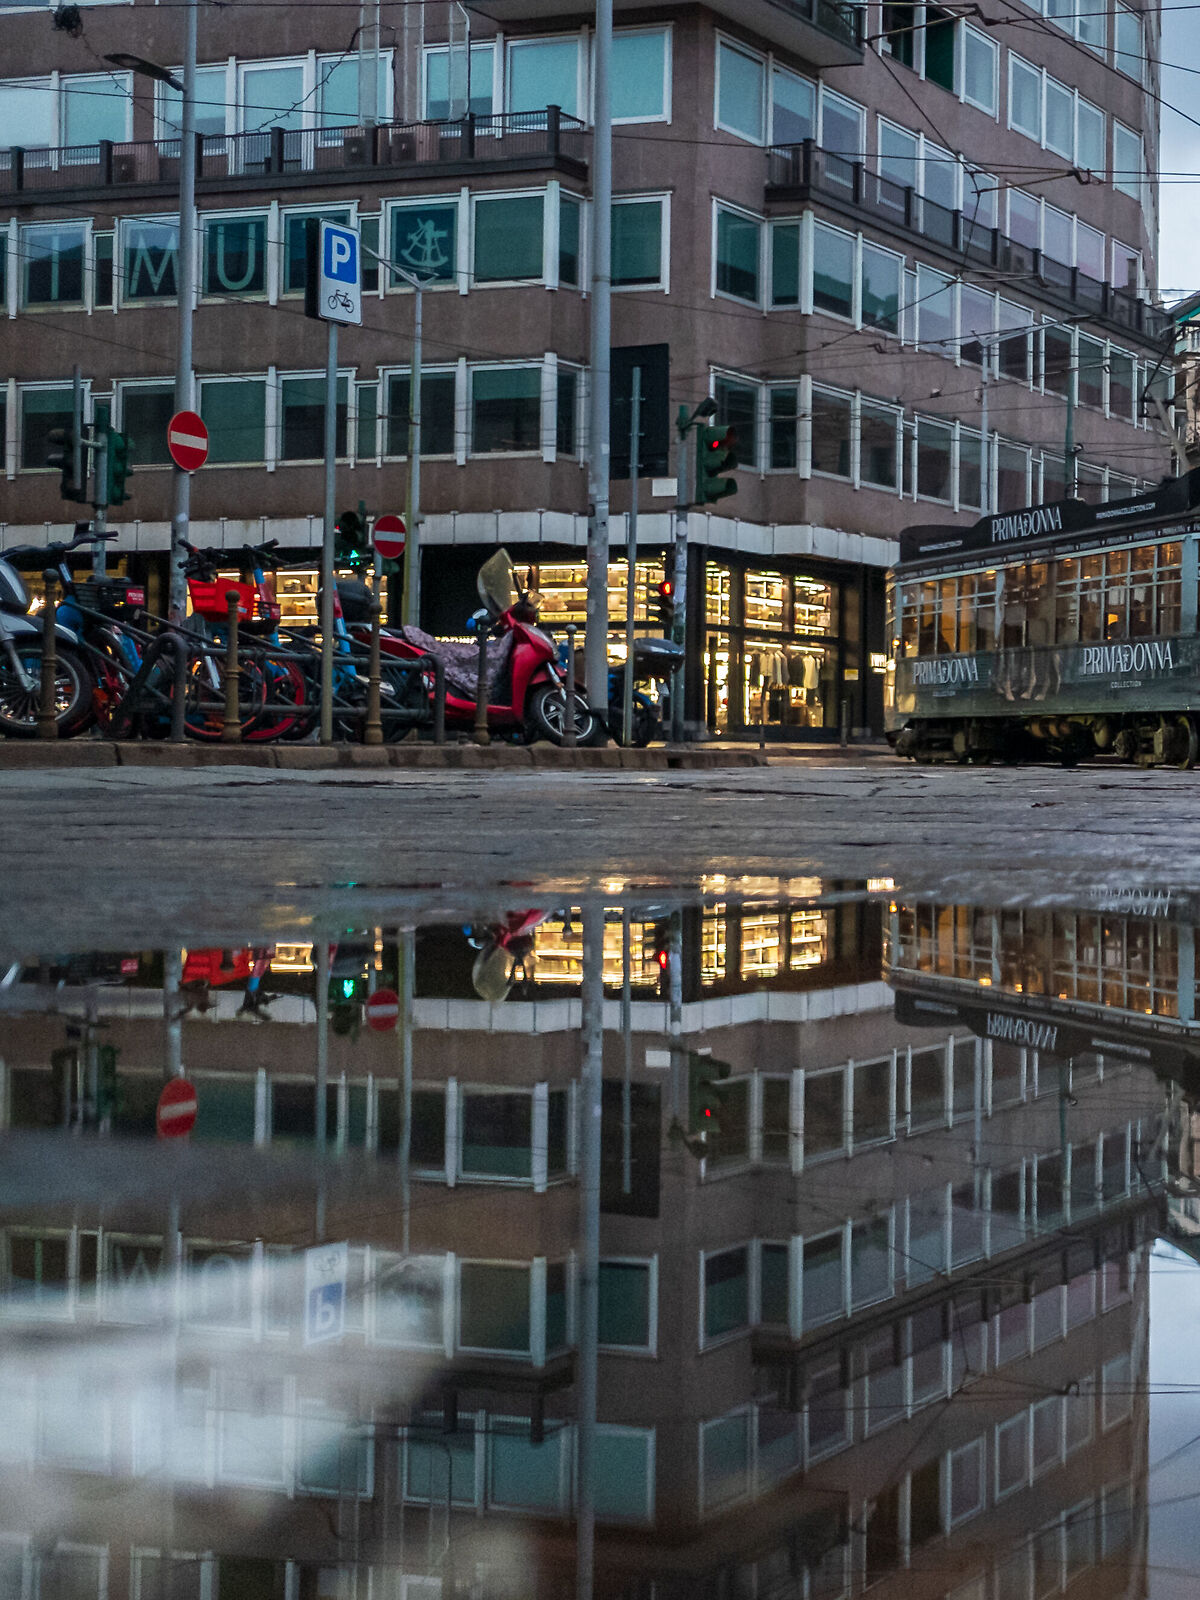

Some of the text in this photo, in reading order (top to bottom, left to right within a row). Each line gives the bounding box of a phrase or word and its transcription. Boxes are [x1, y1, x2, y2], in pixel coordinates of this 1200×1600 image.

[331, 234, 351, 275] P
[991, 506, 1063, 542] PRIMADONNA
[912, 657, 979, 684] PRIMADONNA
[1082, 641, 1173, 674] PRIMADONNA
[1110, 680, 1142, 689] COLLECTION
